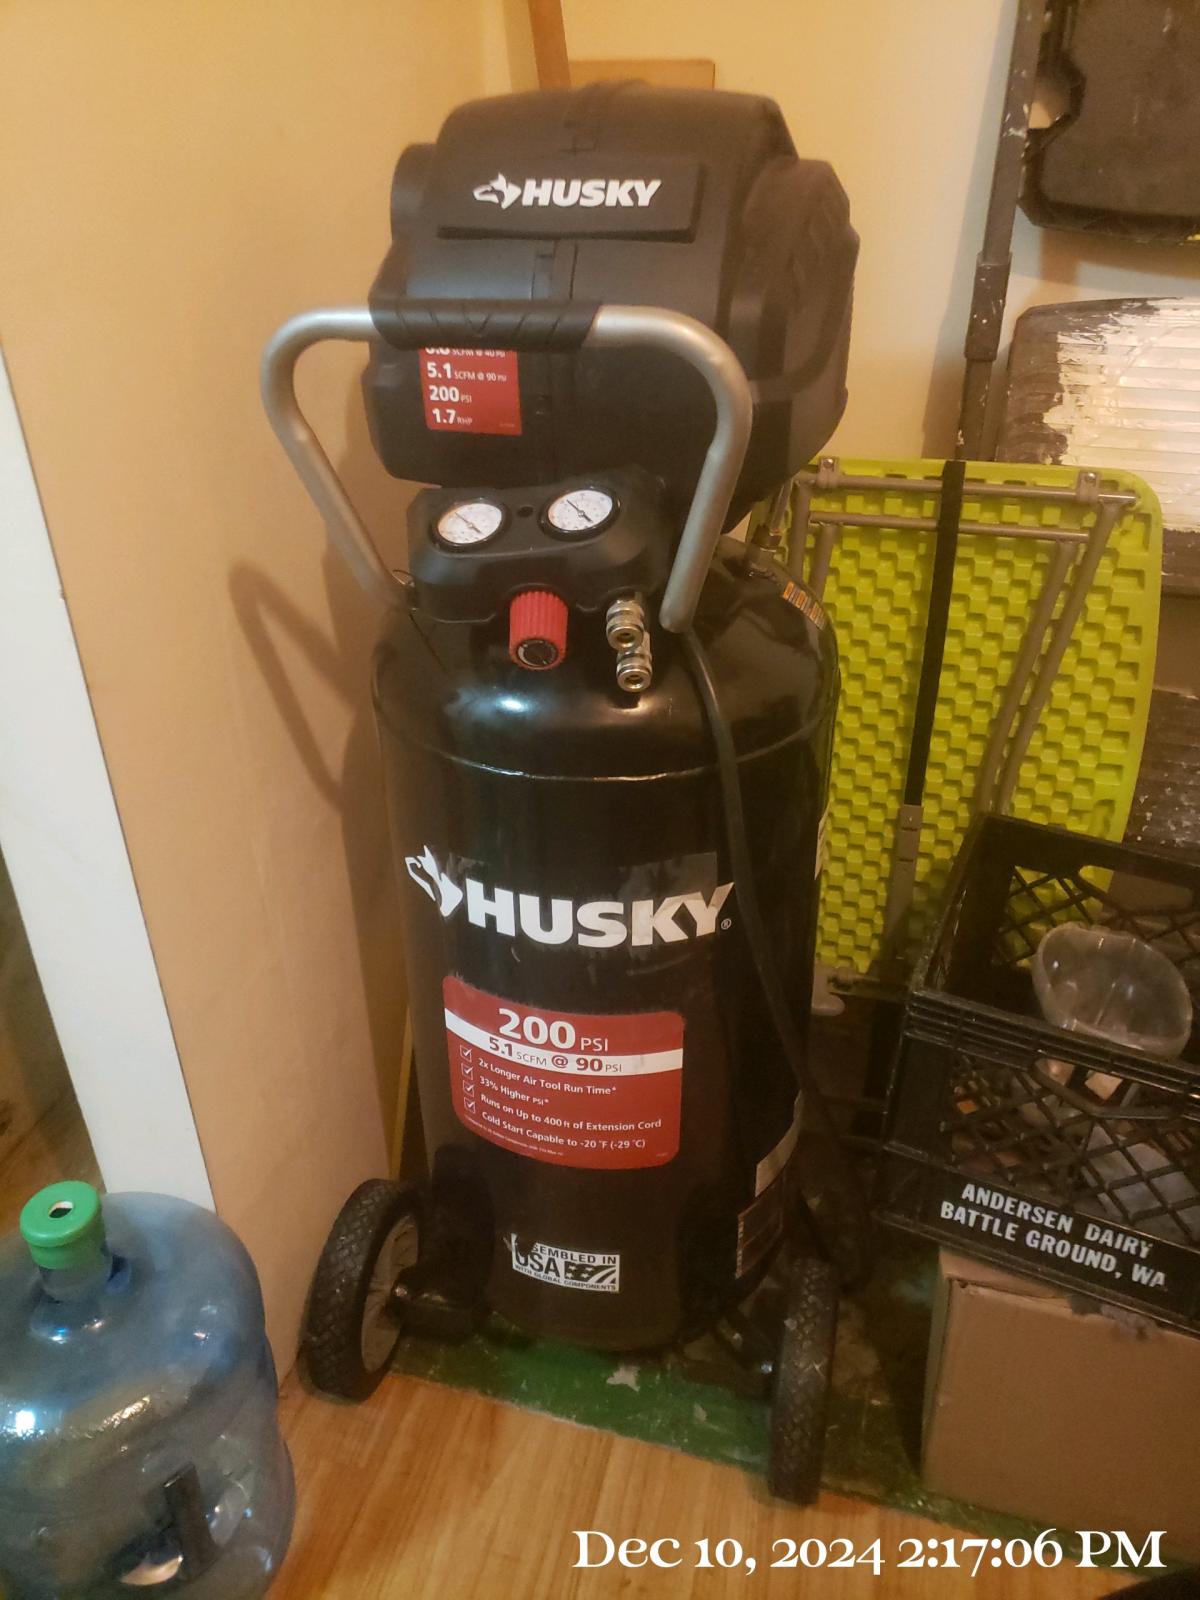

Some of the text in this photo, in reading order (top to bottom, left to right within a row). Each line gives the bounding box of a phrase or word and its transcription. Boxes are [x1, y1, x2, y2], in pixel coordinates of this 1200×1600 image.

[522, 179, 662, 207] HUSKY
[427, 361, 452, 379] 5.1
[454, 371, 475, 380] SCFM
[486, 372, 497, 382] 90
[429, 385, 472, 403] 200 PSI
[432, 408, 456, 424] 1.7
[498, 1007, 609, 1052] 200 PSI
[489, 1036, 622, 1073] 5.1 SCFM @ 90 PSI
[478, 1057, 489, 1069] 2x
[490, 1063, 521, 1081] Longer
[523, 1075, 537, 1086] Air
[540, 1079, 561, 1091] Tool
[563, 1083, 584, 1094] Run
[479, 1075, 499, 1091] 33%
[500, 1085, 530, 1102] Higher
[481, 1094, 501, 1109] Runs
[503, 1105, 514, 1114] on
[516, 1108, 529, 1120] Up
[531, 1113, 542, 1123] to
[543, 1116, 562, 1127] 400
[573, 1120, 583, 1130] of
[586, 1122, 635, 1131] Extension
[637, 1119, 662, 1130] Cord
[481, 1111, 501, 1126] Cold
[502, 1120, 524, 1136] Start
[526, 1129, 565, 1146] Capable
[567, 1138, 577, 1147] to
[580, 1140, 597, 1149] -20
[961, 1183, 1154, 1259] ANDERSEN DAIRY
[602, 1255, 617, 1265] IN
[940, 1200, 1167, 1288] BATTLE GROUND, WA
[563, 1279, 617, 1291] COMPONENTS
